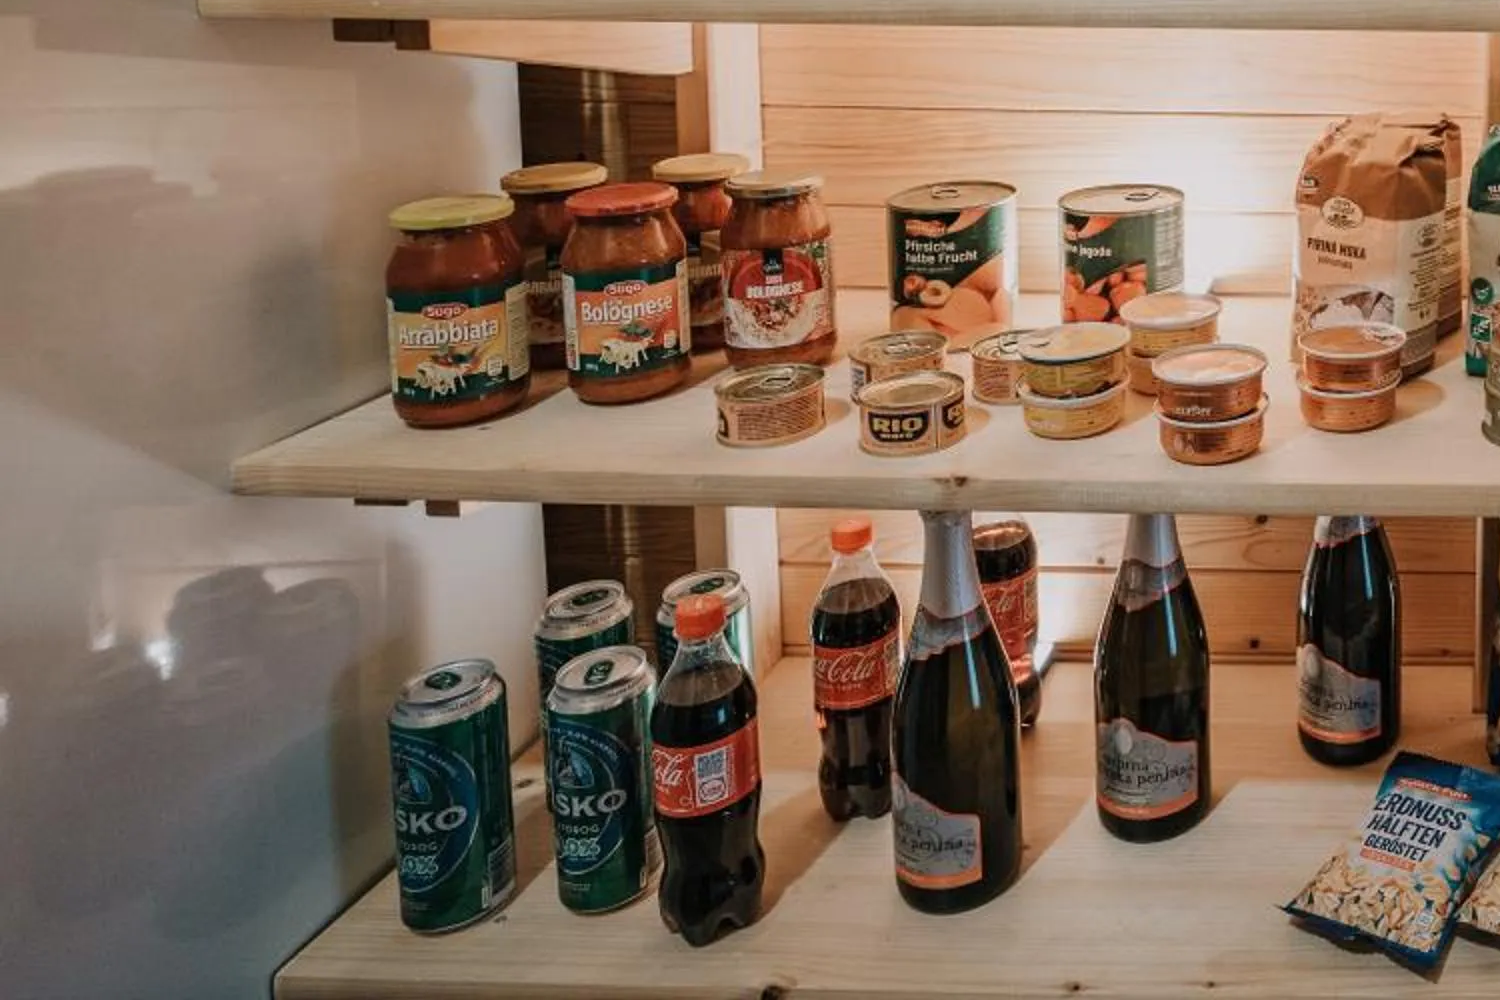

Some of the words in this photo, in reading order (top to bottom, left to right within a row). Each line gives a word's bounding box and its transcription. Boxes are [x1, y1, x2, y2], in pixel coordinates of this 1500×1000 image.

[580, 295, 673, 327] Bolognese
[400, 319, 498, 346] Arrabbiata
[872, 416, 923, 433] RIO
[1373, 793, 1467, 831] ERDNUSS
[1367, 812, 1447, 849] HÄLFTEN
